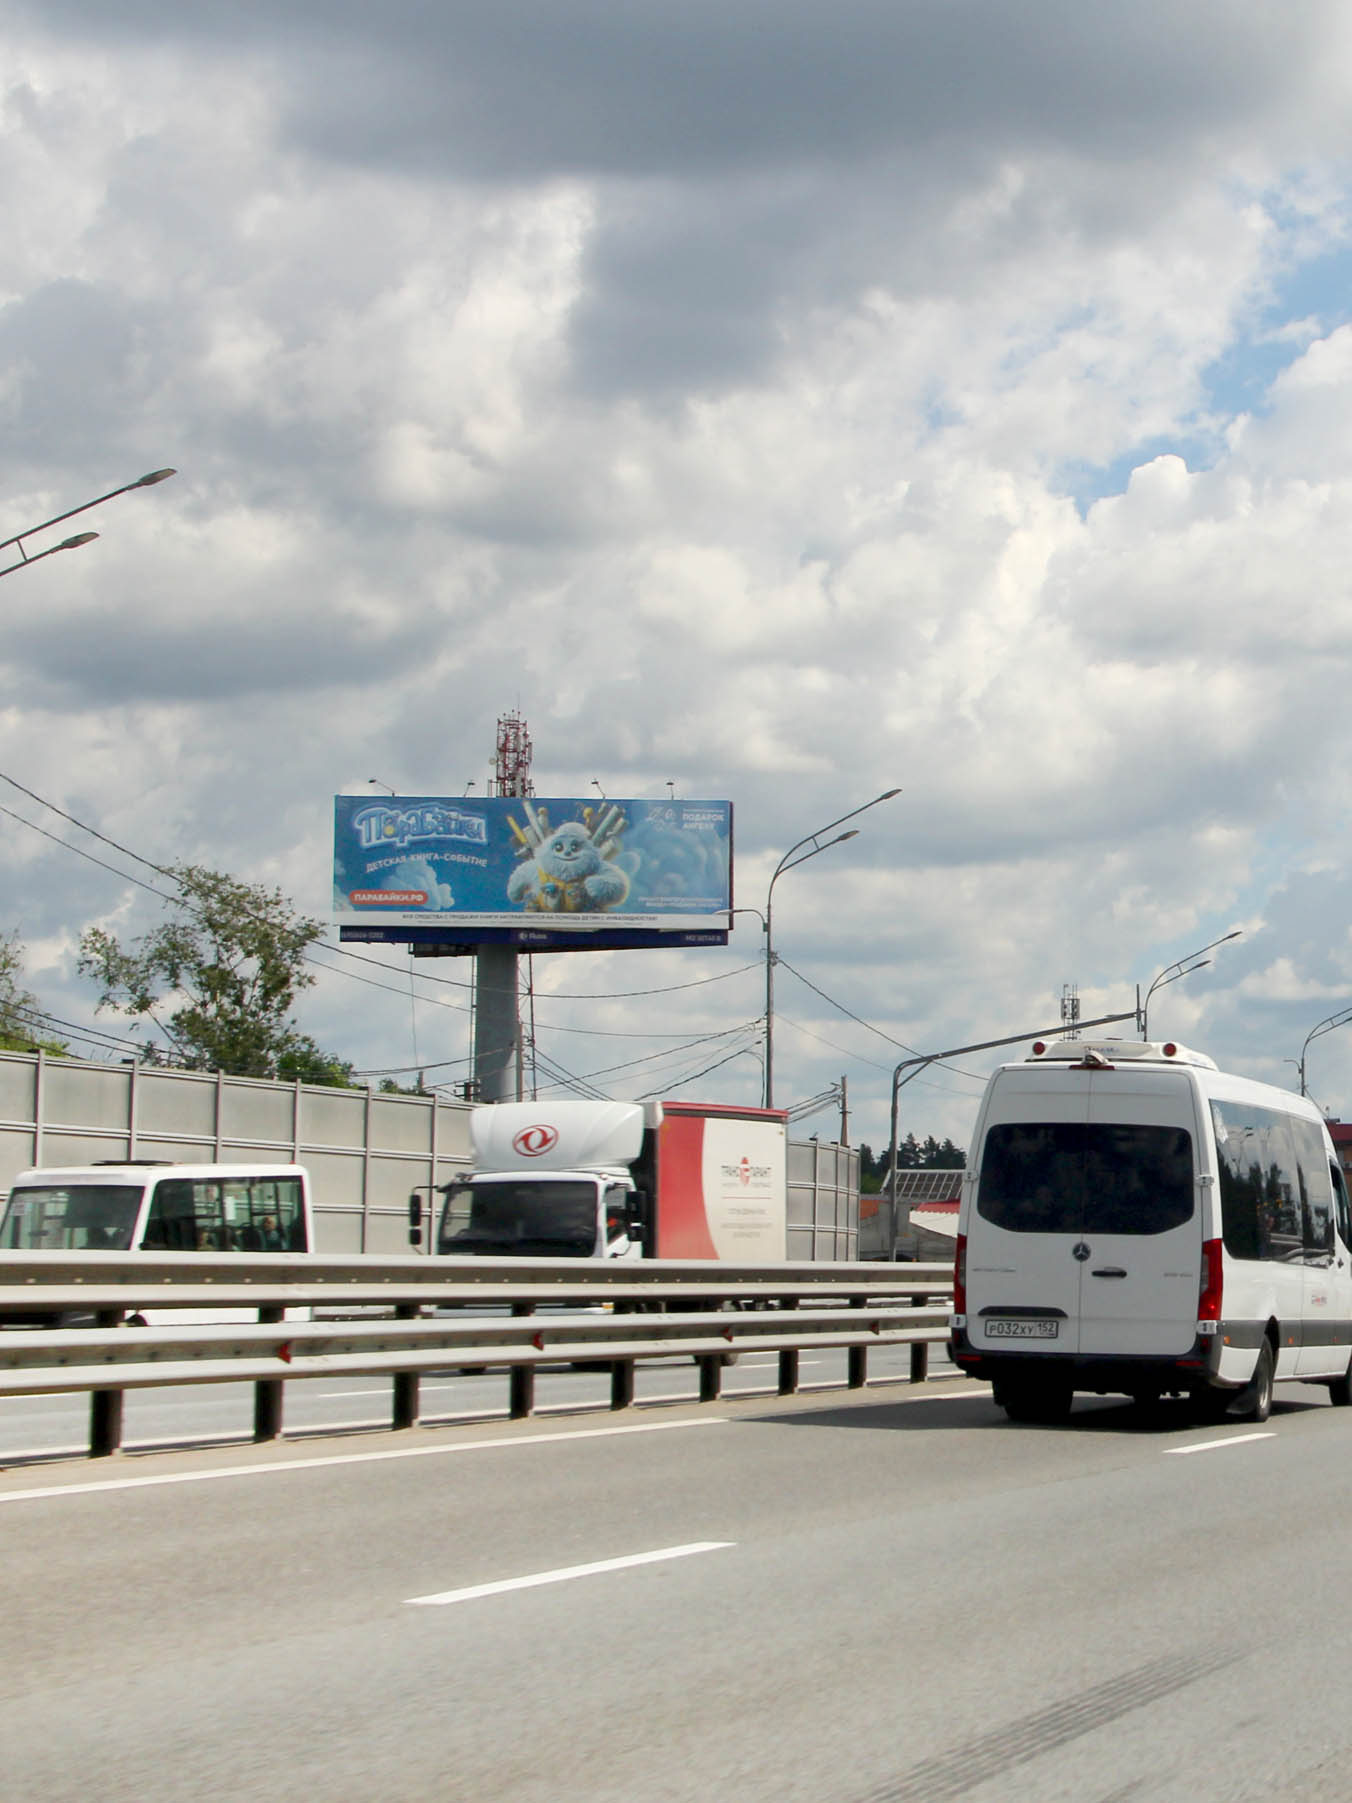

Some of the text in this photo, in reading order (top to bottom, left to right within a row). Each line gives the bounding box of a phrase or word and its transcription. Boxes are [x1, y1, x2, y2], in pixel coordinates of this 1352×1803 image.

[366, 852, 488, 873] ДЕТСКАЯ КНИГА-СОБЫТИЕ
[354, 892, 424, 902] ПАРАБАЙКИ.РФ
